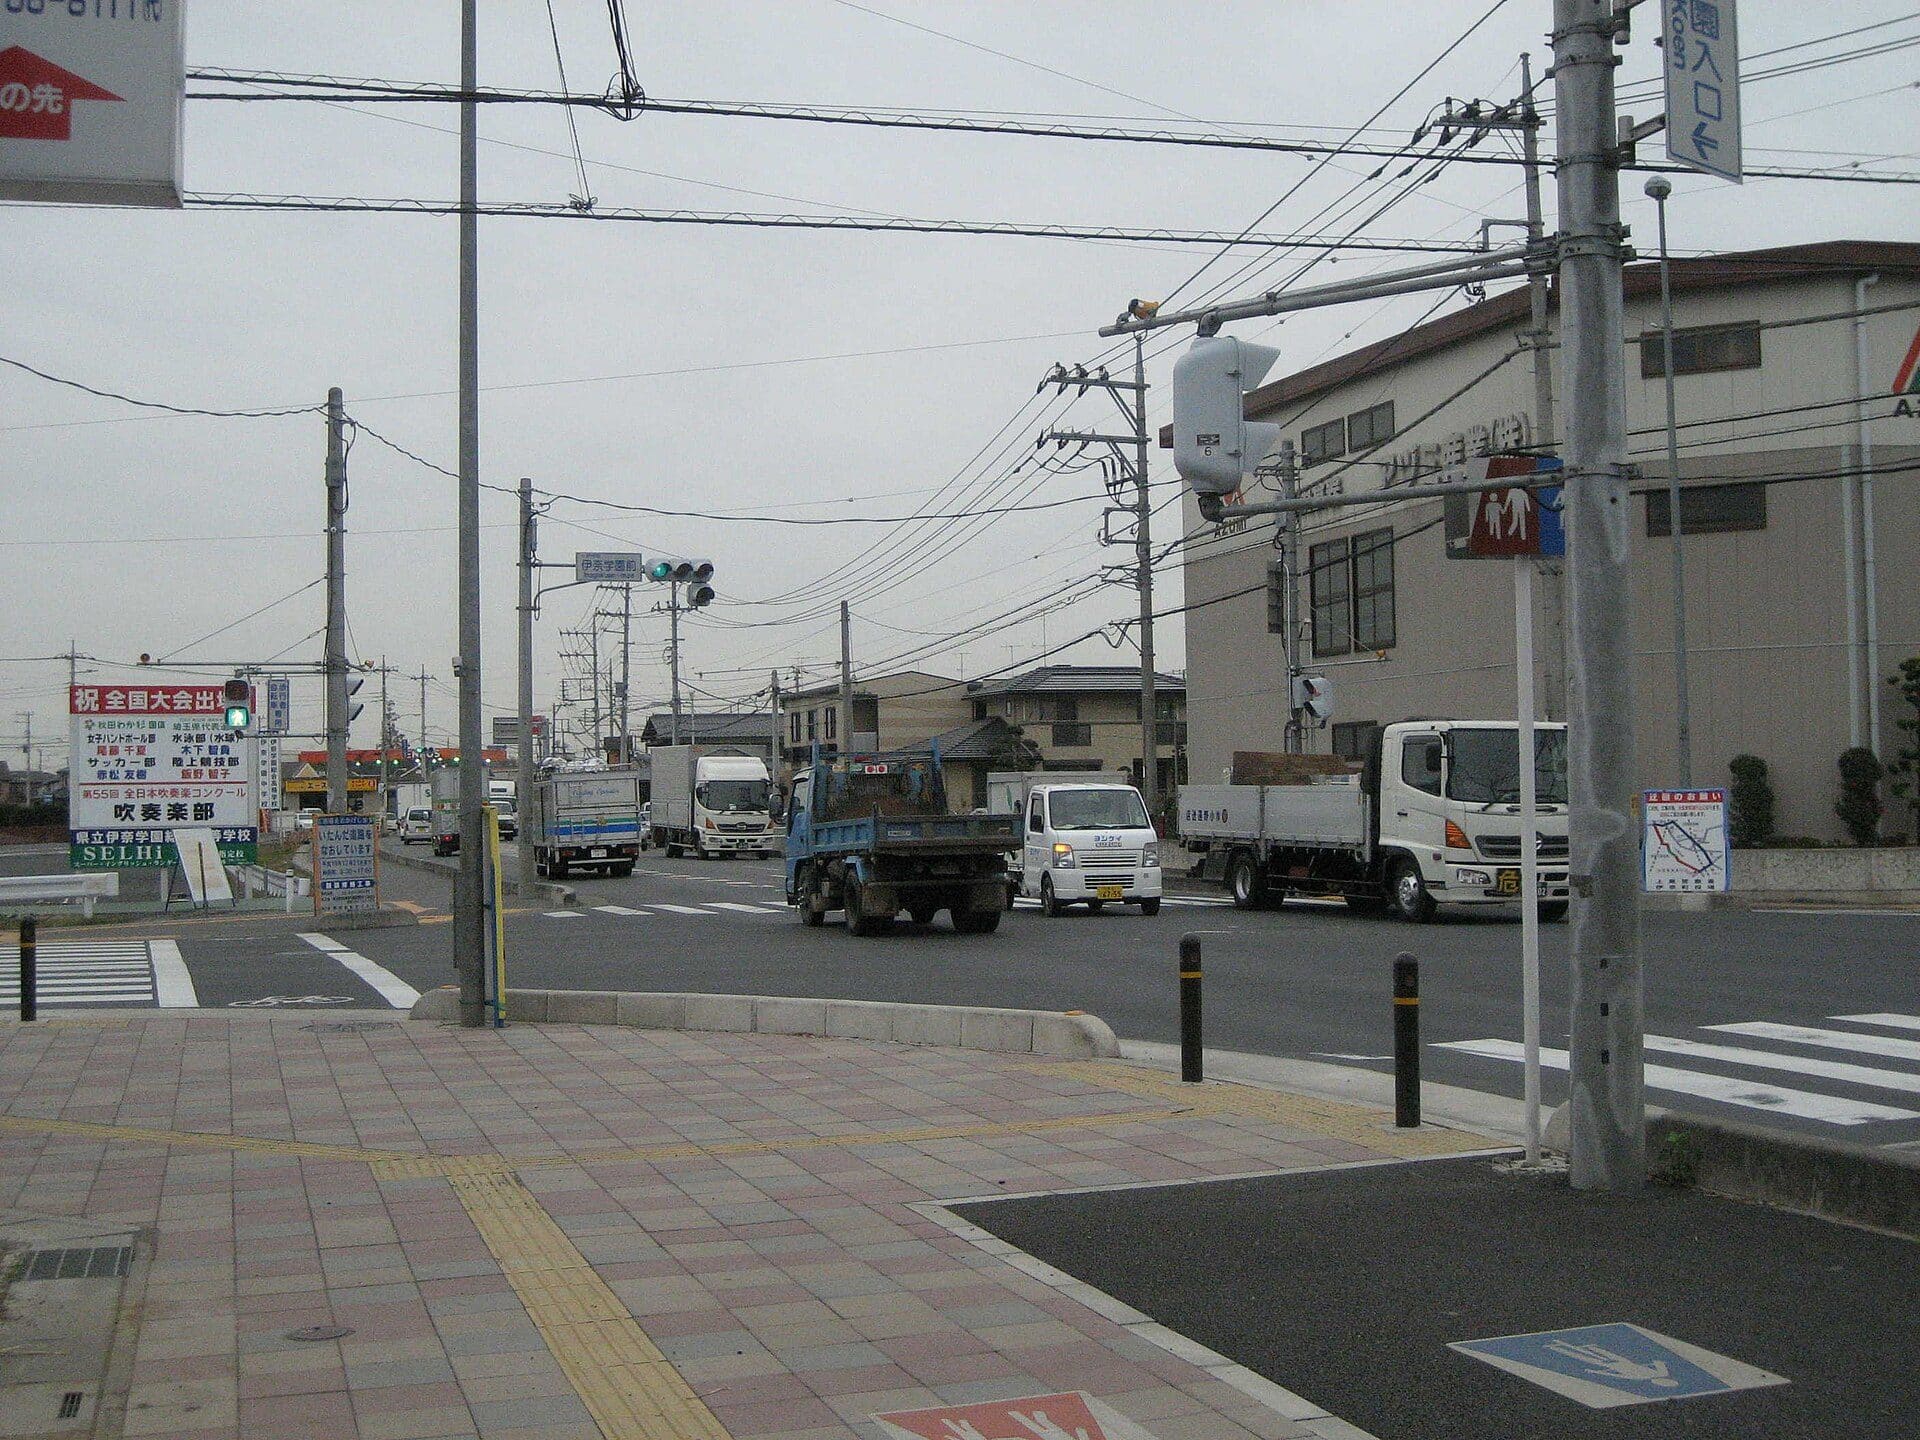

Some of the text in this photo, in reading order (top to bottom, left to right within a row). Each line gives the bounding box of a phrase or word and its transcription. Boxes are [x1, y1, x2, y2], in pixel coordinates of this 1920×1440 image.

[582, 559, 636, 572] 伊奈学園前
[75, 689, 99, 712] 祝
[87, 757, 156, 767] サッカー部
[83, 788, 246, 799] 第55回 全日本吹奏楽コンクール
[114, 802, 215, 821] 吹奏楽部
[83, 844, 163, 861] SELHi
[1498, 869, 1519, 894] 危
